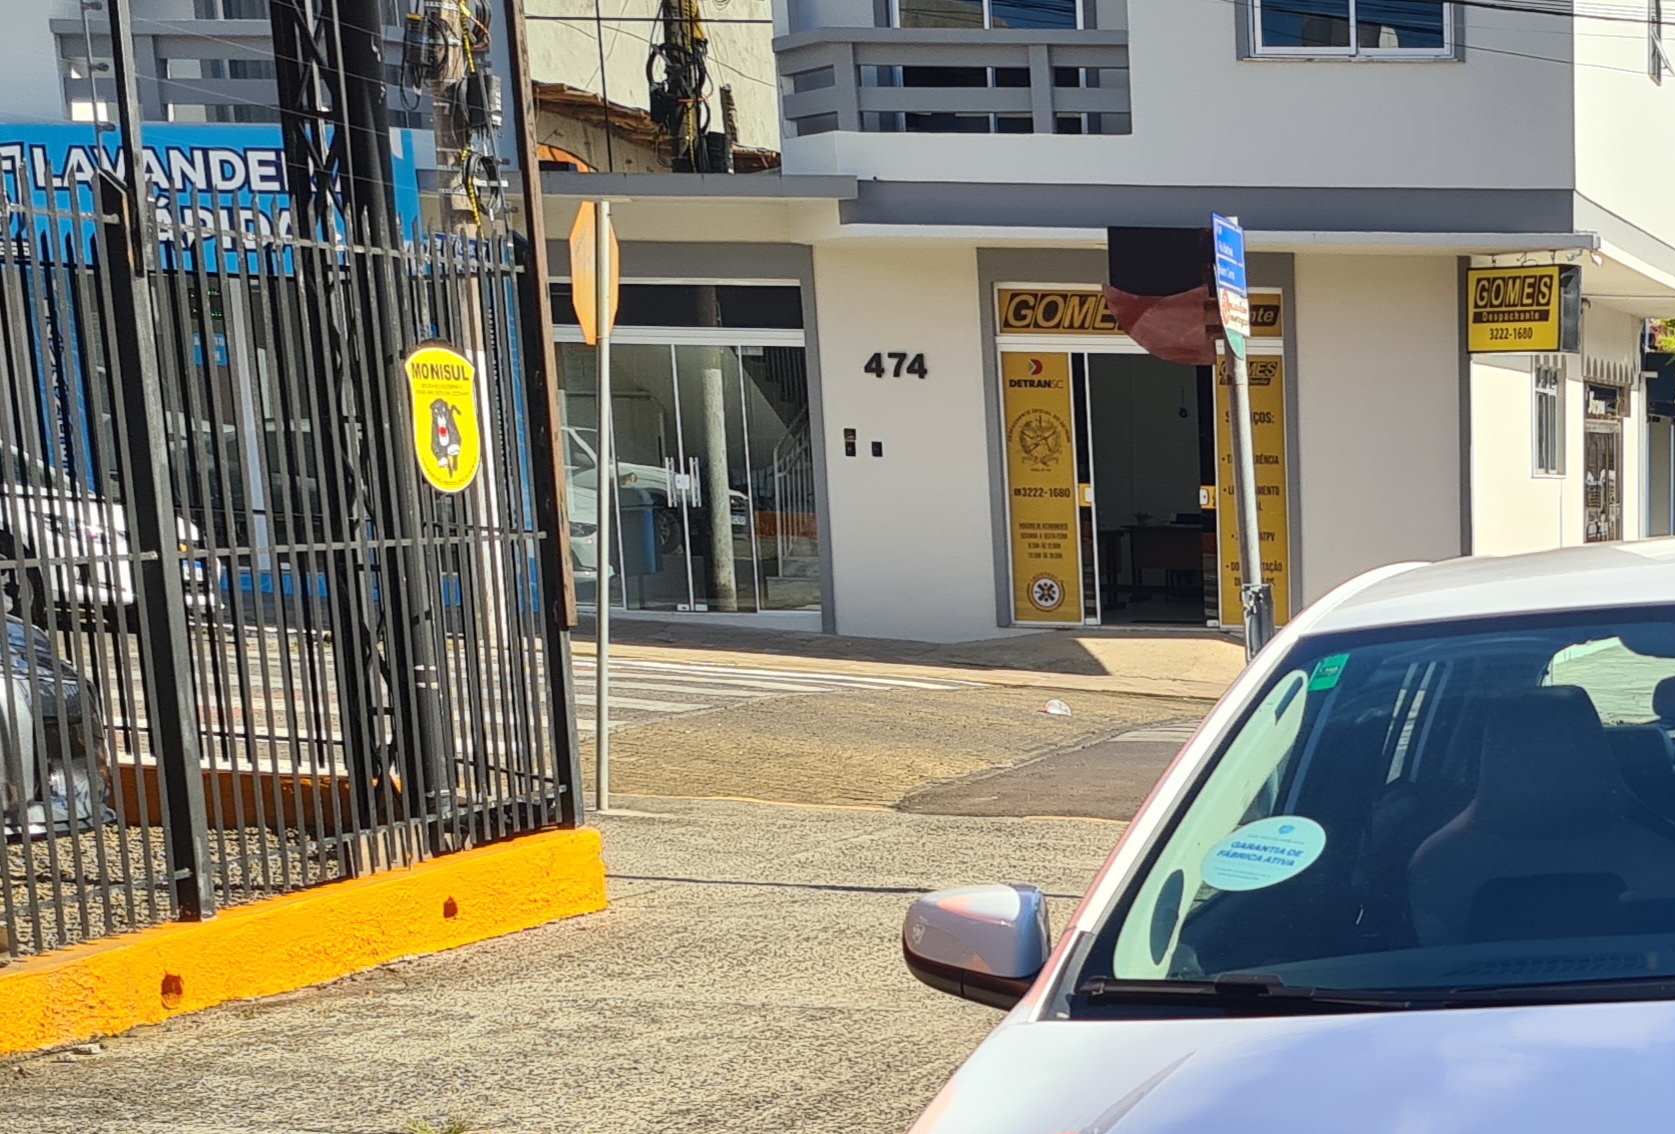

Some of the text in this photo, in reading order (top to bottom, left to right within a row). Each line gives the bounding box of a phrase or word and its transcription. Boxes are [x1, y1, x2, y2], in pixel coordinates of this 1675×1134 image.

[1474, 275, 1553, 308] GOMES
[1003, 292, 1122, 330] GOME
[1481, 310, 1540, 323] Despachante
[1489, 326, 1534, 341] 3222-1680
[411, 362, 470, 382] MONISUL
[863, 352, 928, 379] 474
[1021, 487, 1071, 499] 3222-1680
[1230, 841, 1304, 858] GARANTIA DE
[1263, 855, 1296, 867] ATIVA
